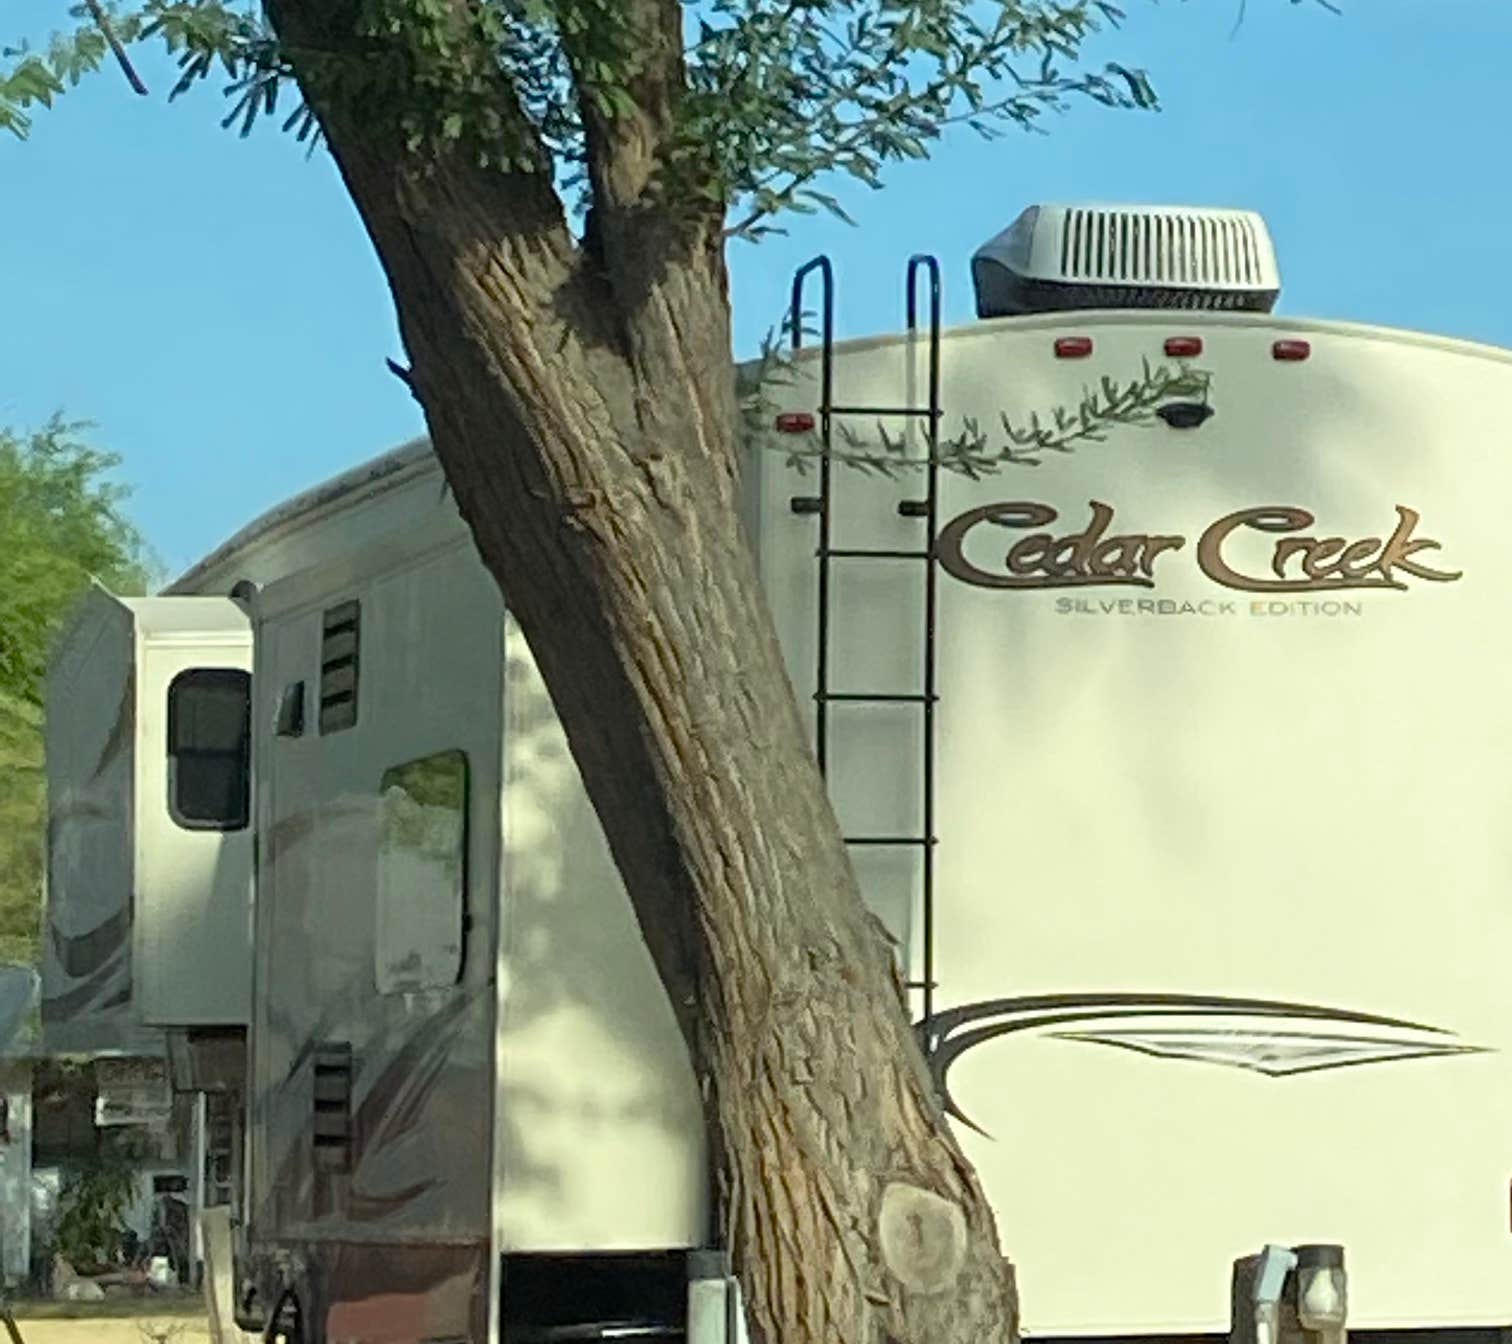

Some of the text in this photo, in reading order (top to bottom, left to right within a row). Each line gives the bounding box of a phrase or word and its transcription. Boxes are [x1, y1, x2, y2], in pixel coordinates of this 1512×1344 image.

[934, 499, 1463, 593] Cedar Creek
[1054, 597, 1363, 617] SILVERBACK EDITION
